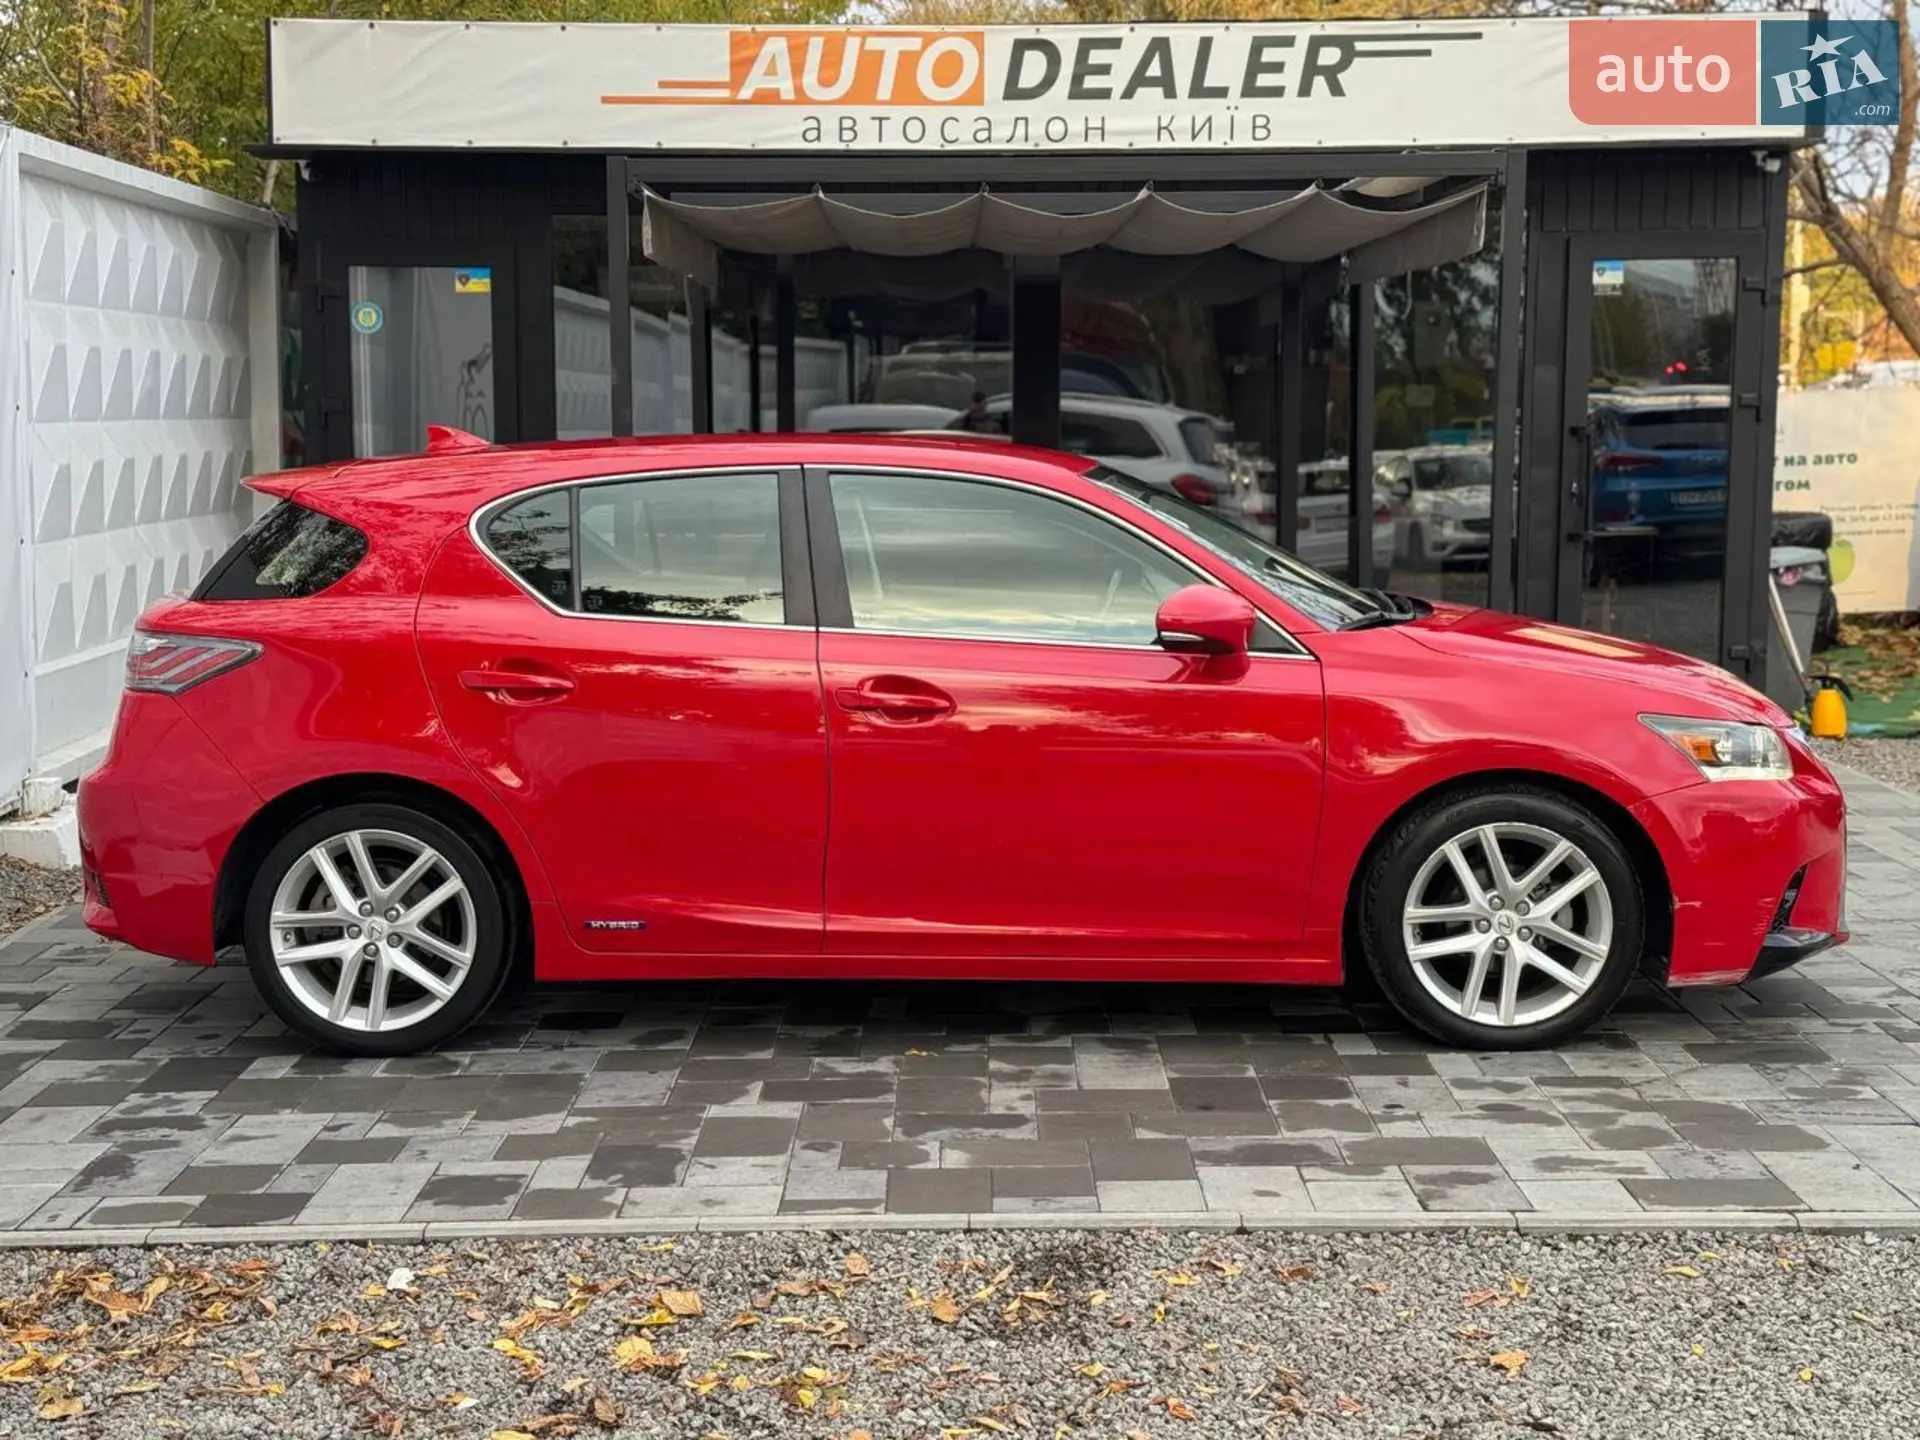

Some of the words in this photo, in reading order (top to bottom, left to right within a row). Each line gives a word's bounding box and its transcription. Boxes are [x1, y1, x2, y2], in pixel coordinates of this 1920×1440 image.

[736, 36, 980, 101] AUTO
[1002, 34, 1356, 101] DEALER
[802, 115, 1106, 144] автосалон
[1157, 105, 1272, 143] київ
[1784, 455, 1807, 467] на
[1813, 453, 1858, 466] авто
[591, 920, 639, 929] HYBRID
